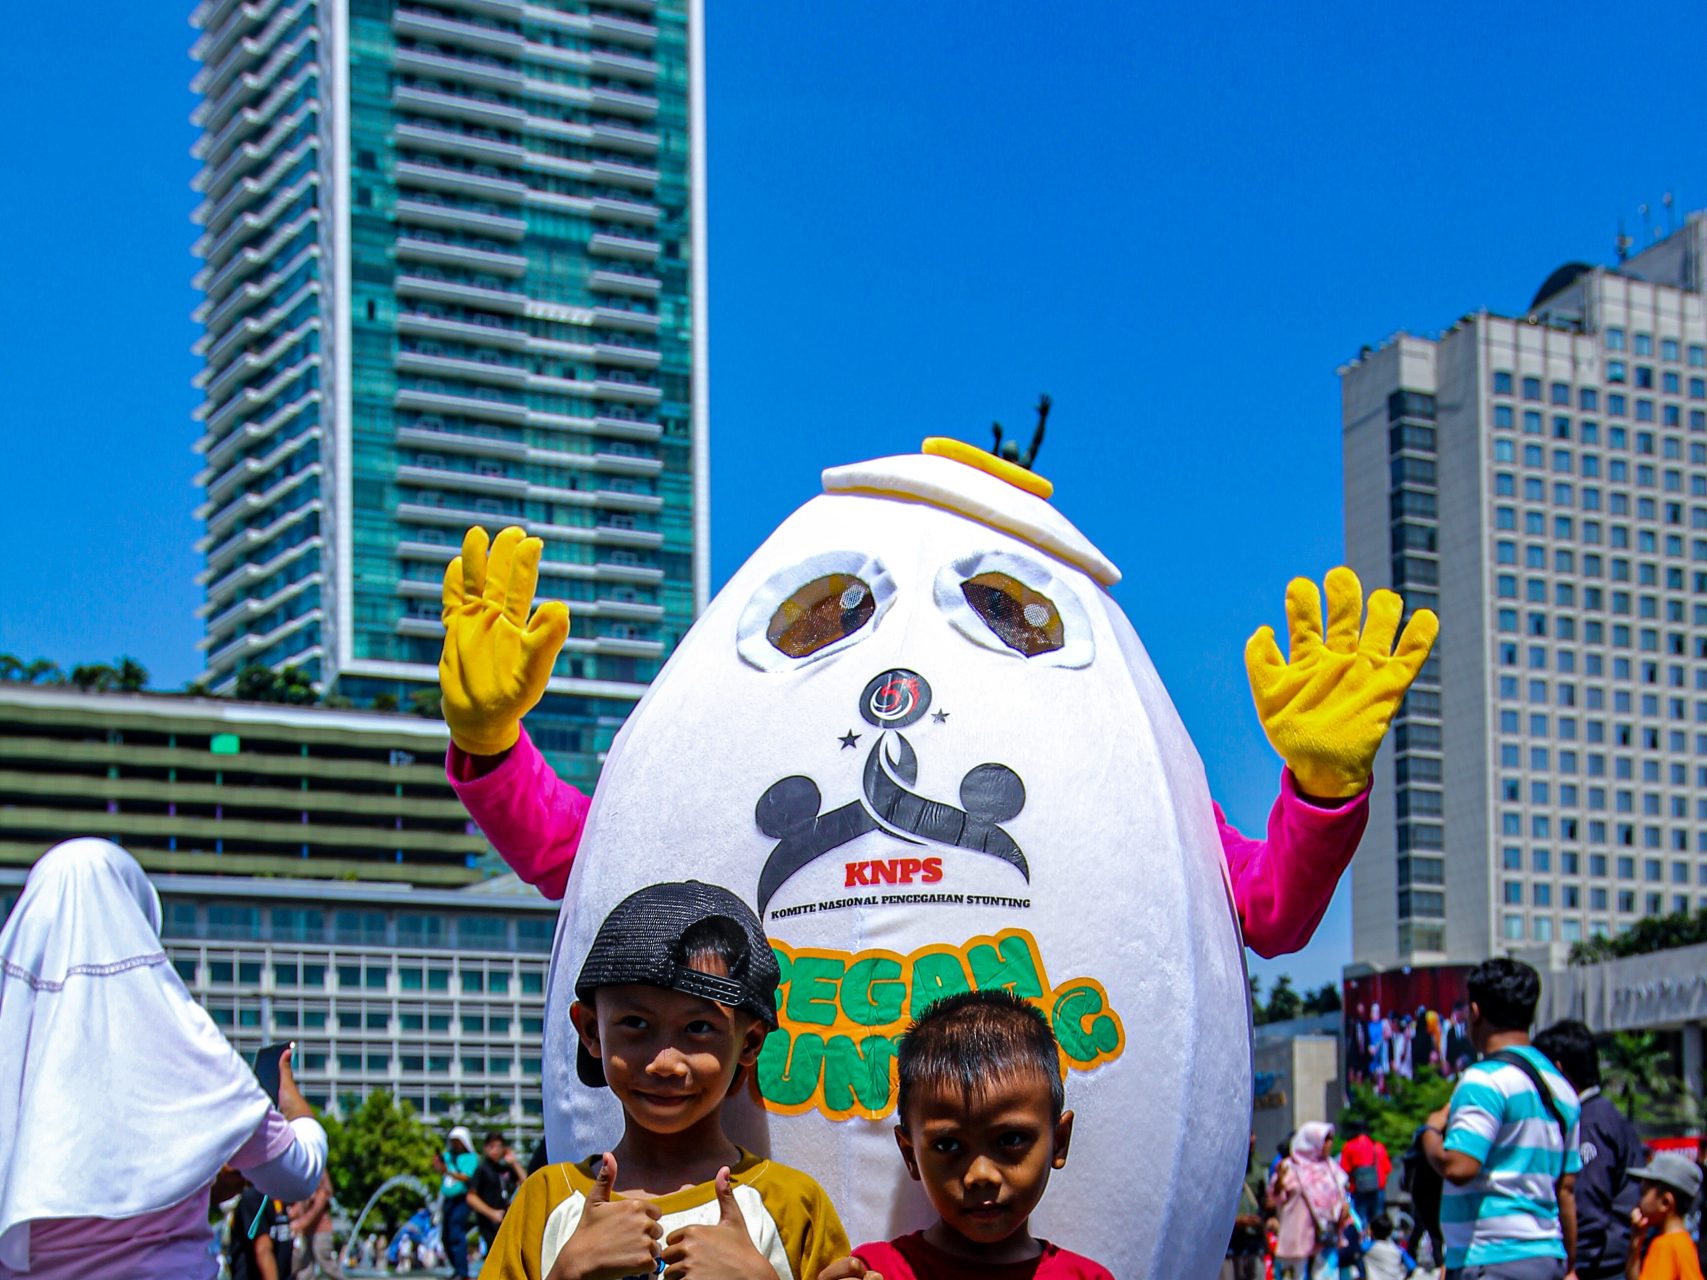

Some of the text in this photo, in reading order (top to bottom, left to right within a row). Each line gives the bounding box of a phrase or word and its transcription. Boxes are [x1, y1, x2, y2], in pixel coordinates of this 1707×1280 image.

[845, 857, 943, 887] KNPS
[770, 894, 1031, 920] KOMITE NASIONAL PENCEGAHAN STUNTING
[774, 936, 1043, 1026] EGAH
